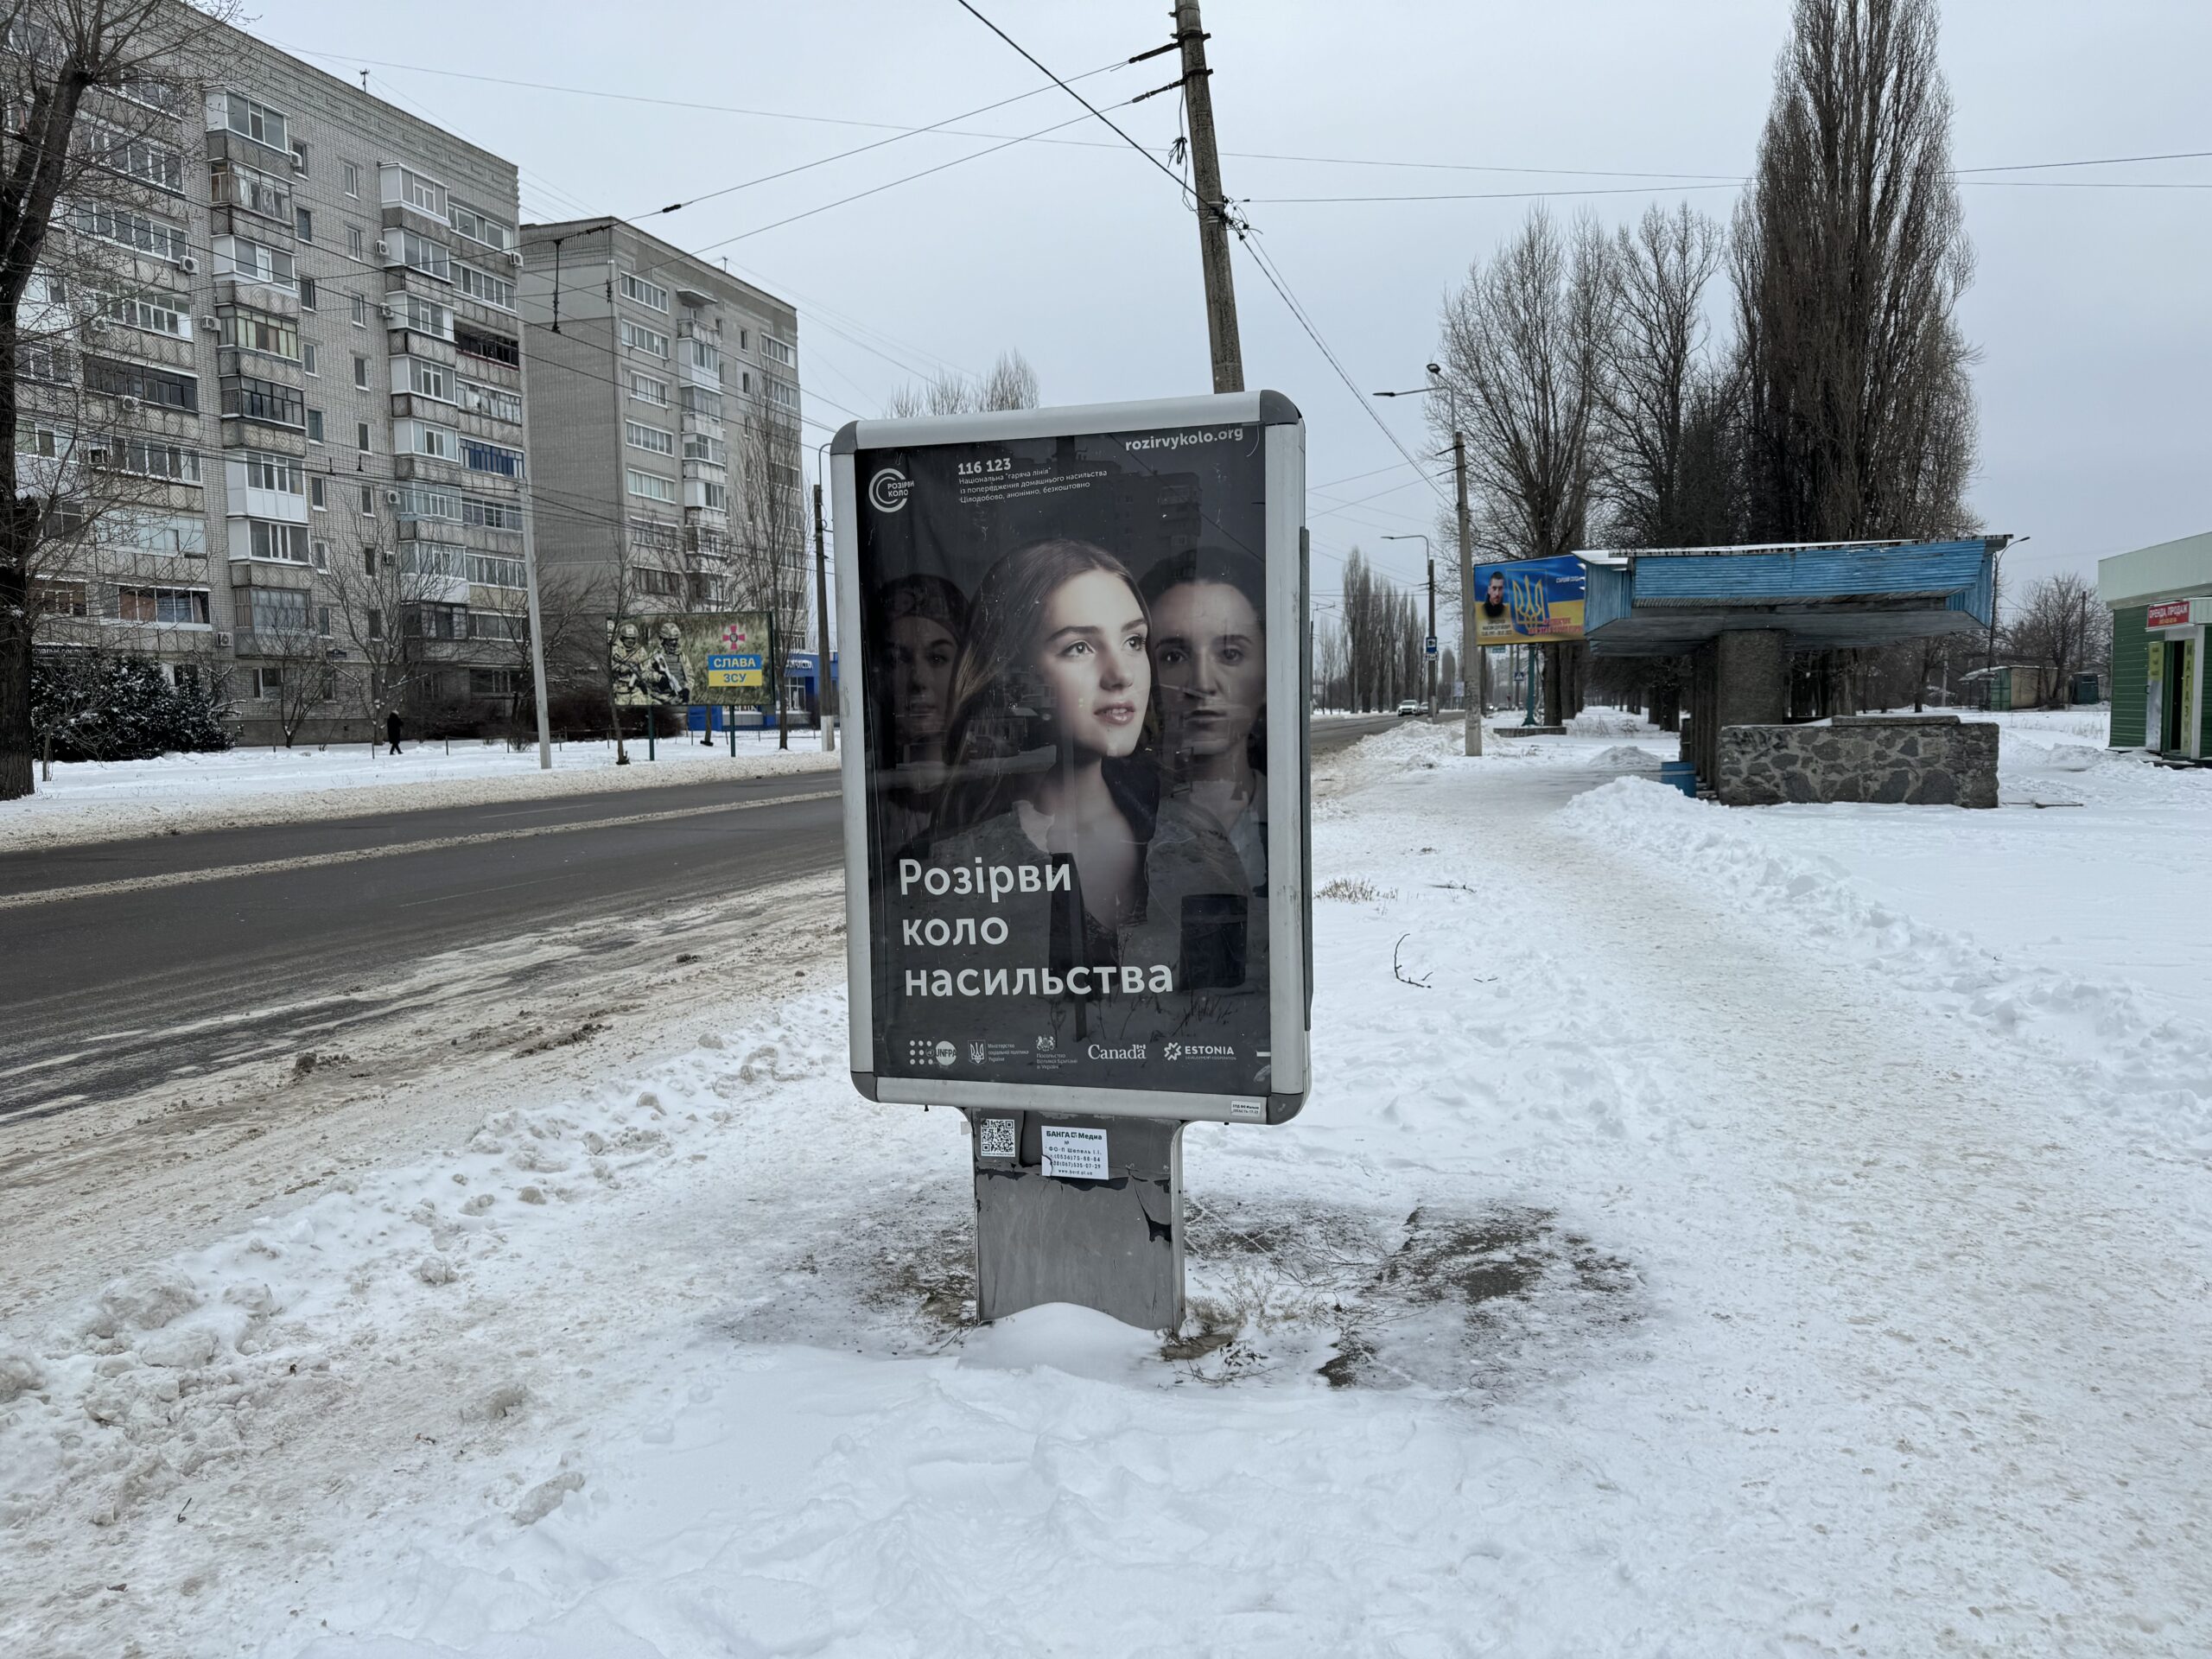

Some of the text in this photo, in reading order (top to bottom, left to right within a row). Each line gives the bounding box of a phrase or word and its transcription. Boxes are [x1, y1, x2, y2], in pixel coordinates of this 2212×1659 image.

[1125, 428, 1243, 451] rozirvykolo.org
[957, 457, 1012, 475] 116 123
[887, 480, 915, 490] РОЗІРВИ
[958, 475, 1004, 485] Національна
[967, 482, 1020, 494] попередження
[1020, 476, 1065, 488] домашнього
[1065, 470, 1108, 480] насильства
[888, 488, 909, 498] КОЛО
[960, 481, 1091, 504] Цілодобово, анонімно, безкоштовно
[2167, 603, 2189, 616] ПРОДАЖ
[713, 658, 756, 668] СЛАВА
[723, 673, 747, 683] ЗСУ
[899, 856, 1071, 903] Розірви
[902, 917, 1009, 947] коло
[906, 963, 1173, 996] насильства
[936, 1048, 957, 1058] UNFPA
[1088, 1044, 1147, 1059] Canada
[1185, 1046, 1235, 1055] ESTONIA
[1078, 1132, 1103, 1141] Медиа
